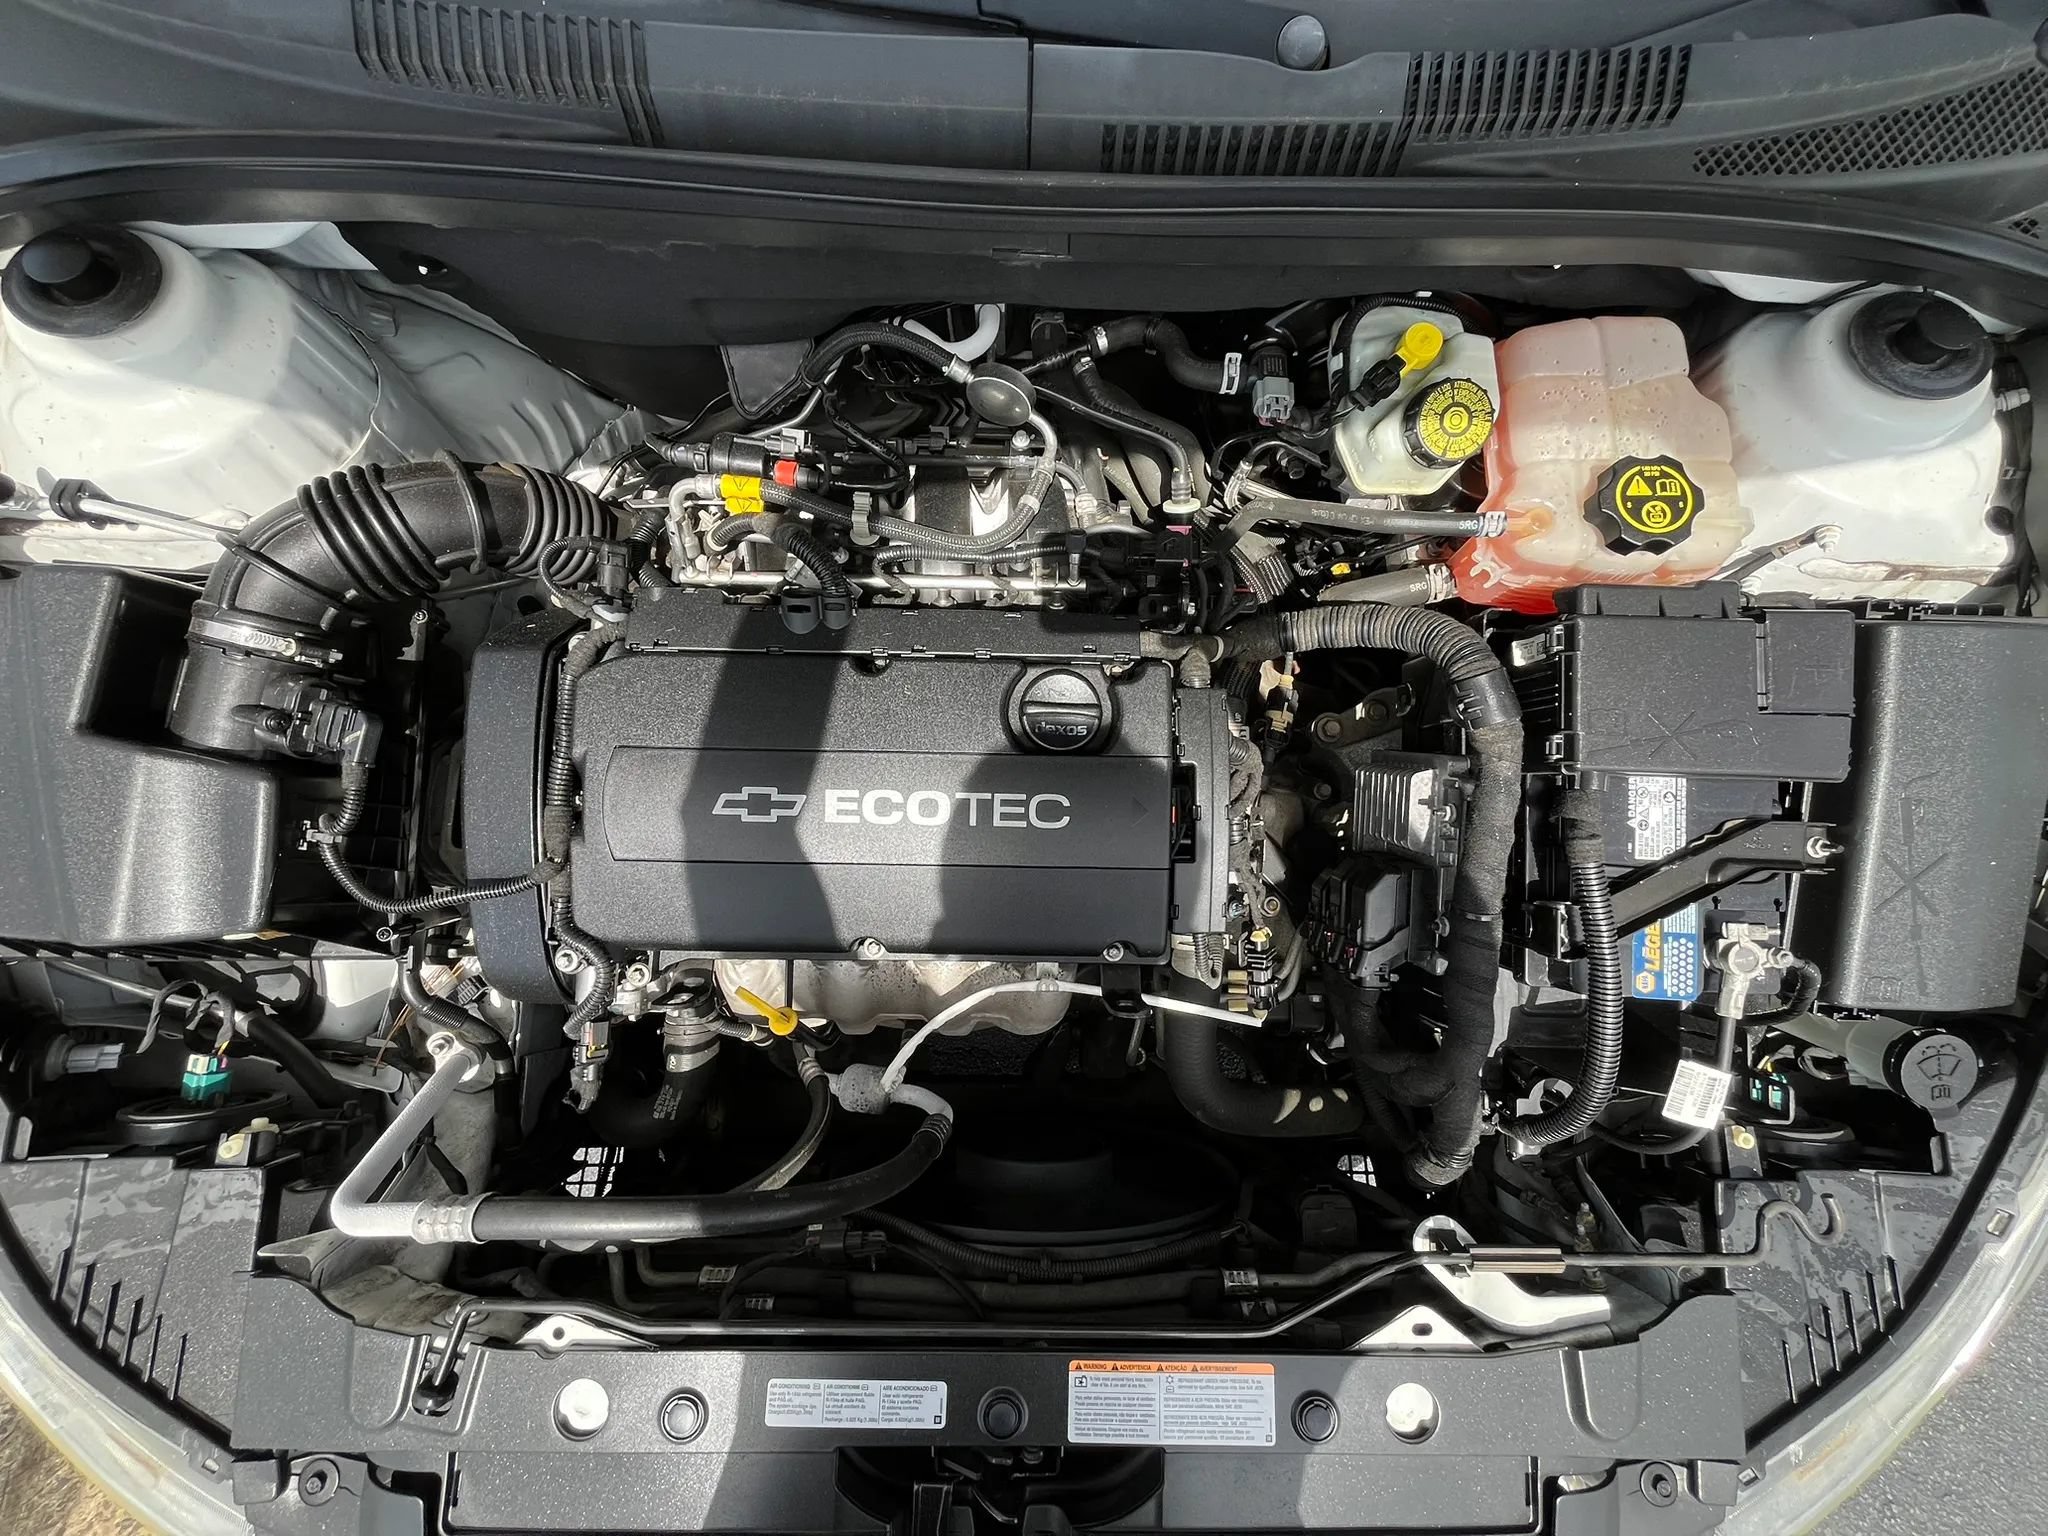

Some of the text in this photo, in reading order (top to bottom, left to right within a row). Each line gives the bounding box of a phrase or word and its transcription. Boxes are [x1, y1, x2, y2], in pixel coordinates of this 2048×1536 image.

[1459, 521, 1478, 530] SRG
[1410, 582, 1427, 592] SRG
[1035, 721, 1087, 736] dexos
[825, 789, 1071, 829] ECOTEC
